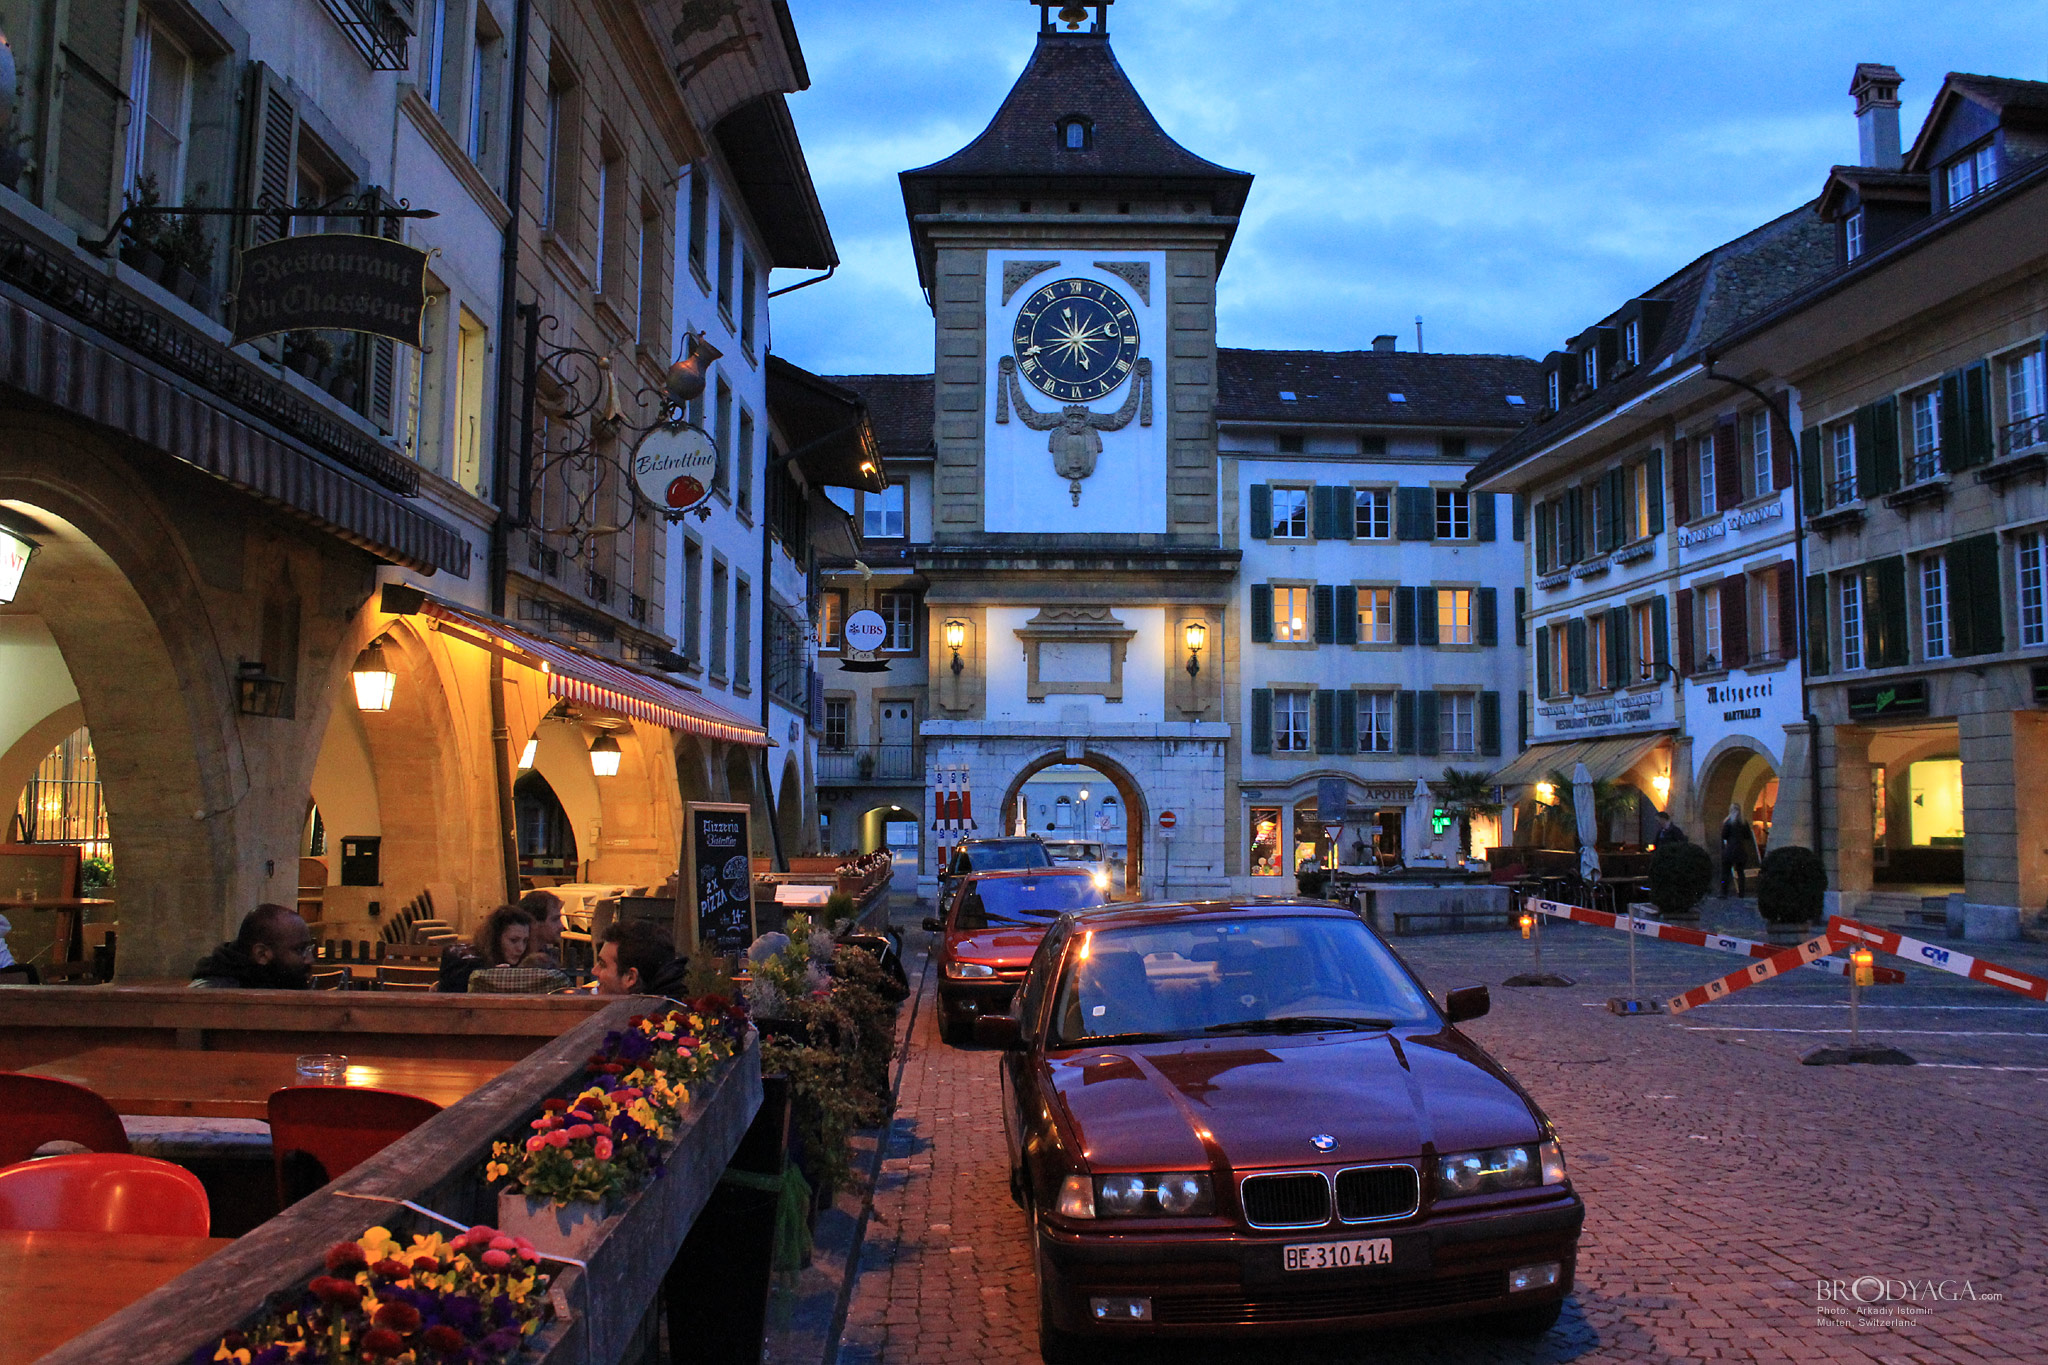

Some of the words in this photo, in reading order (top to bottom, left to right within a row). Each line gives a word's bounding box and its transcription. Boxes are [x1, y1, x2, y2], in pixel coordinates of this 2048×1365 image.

[252, 252, 413, 287] Restaurant
[280, 284, 416, 325] Chasseur
[636, 450, 713, 474] Bistrottino
[862, 625, 883, 634] UBS
[1366, 790, 1415, 800] APOTHE
